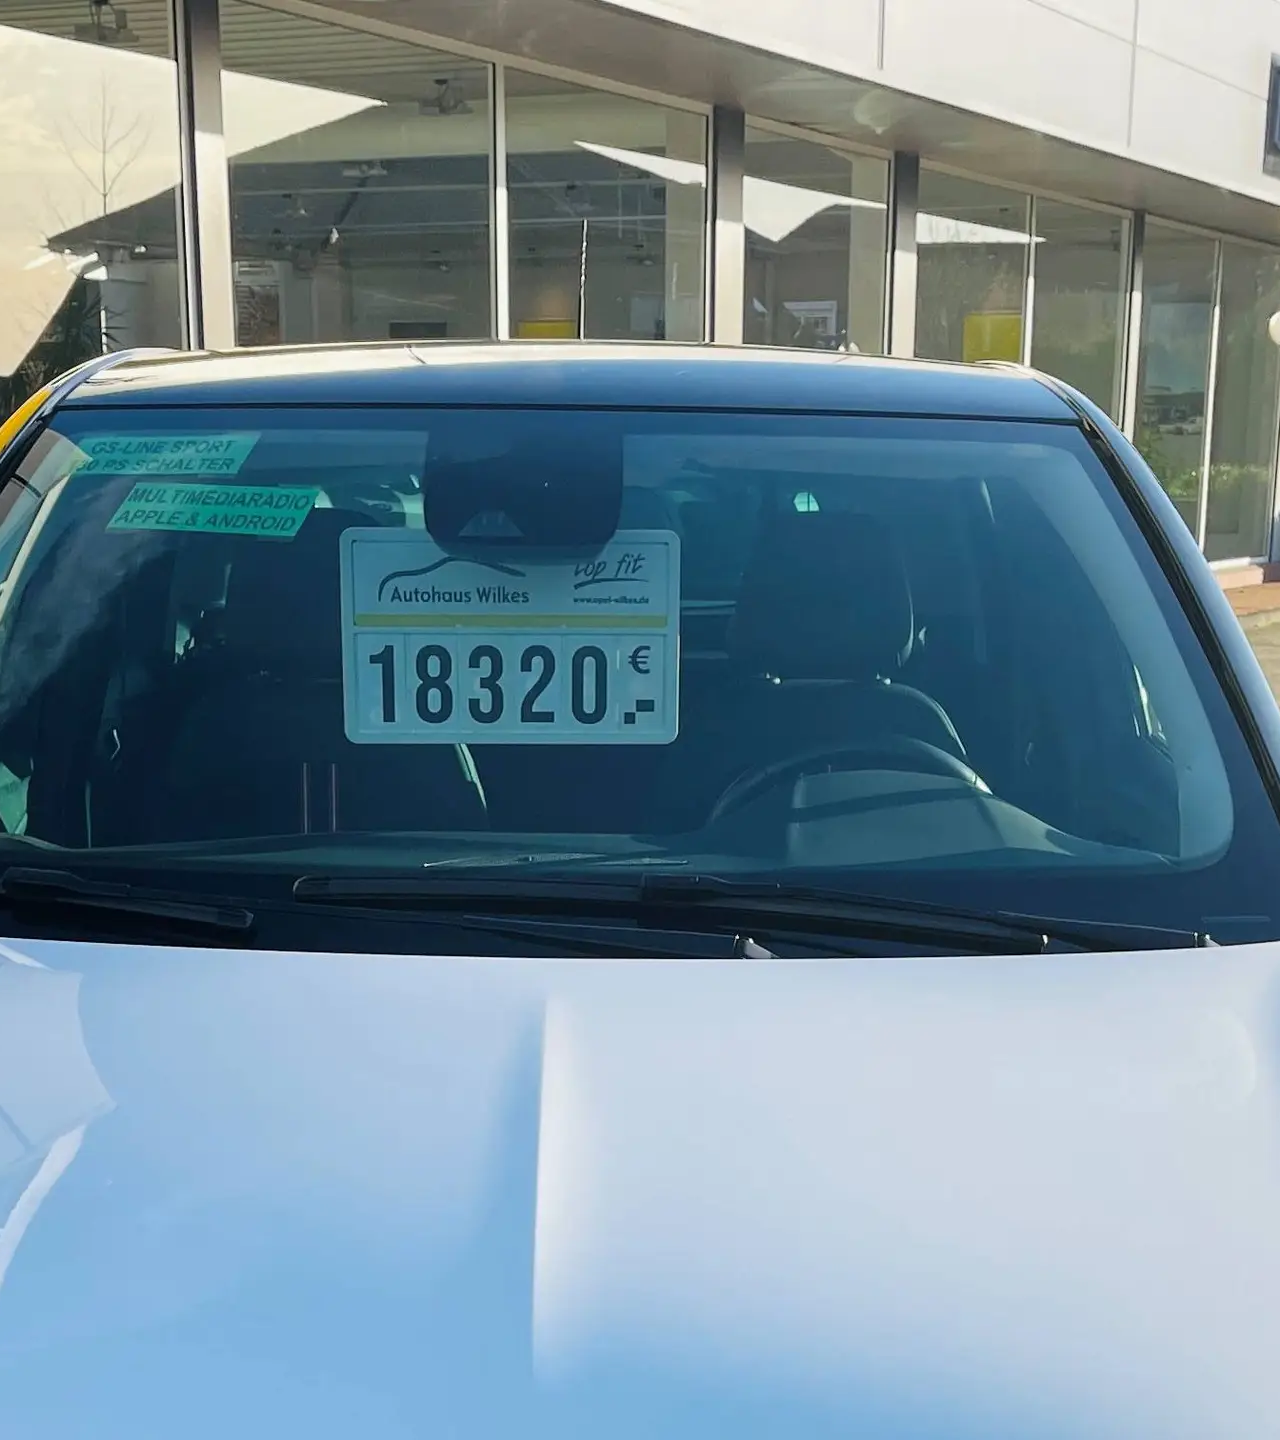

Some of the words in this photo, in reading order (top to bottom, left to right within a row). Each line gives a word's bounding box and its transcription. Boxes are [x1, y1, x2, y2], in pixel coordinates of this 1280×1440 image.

[91, 441, 168, 455] GS-LINE
[170, 440, 237, 454] SPORT
[102, 459, 129, 471] PS
[131, 457, 235, 473] SCHALTER
[127, 487, 310, 510] MULTIMEDIARADIO
[114, 509, 181, 525] APPLE
[185, 512, 202, 527] &
[205, 513, 297, 532] ANDROID
[615, 553, 646, 577] fit
[390, 585, 472, 604] Autohaus
[476, 586, 530, 604] Wilkes
